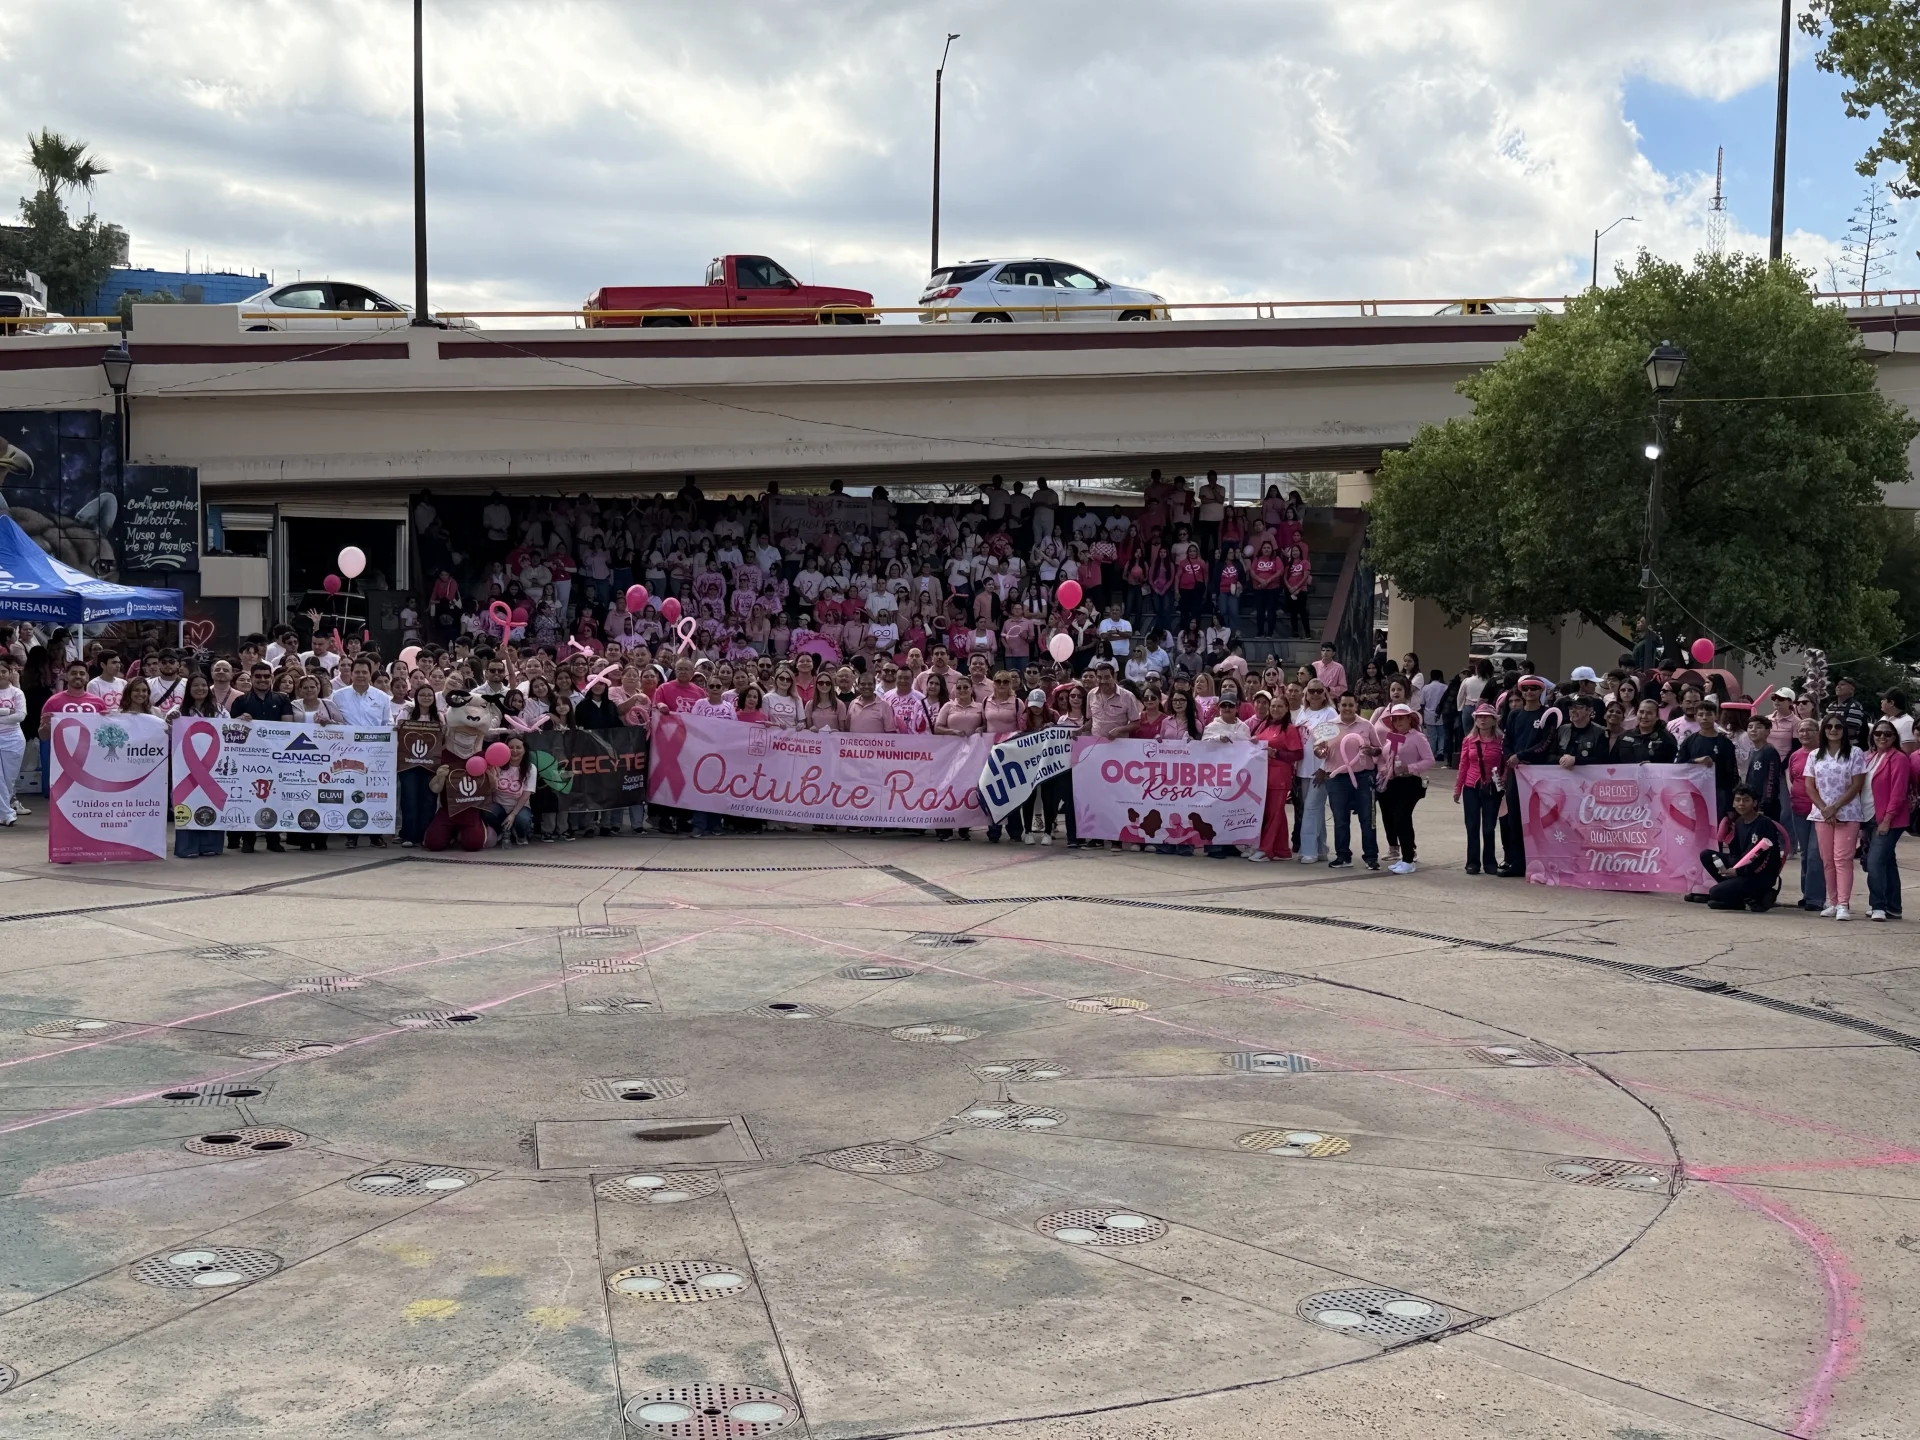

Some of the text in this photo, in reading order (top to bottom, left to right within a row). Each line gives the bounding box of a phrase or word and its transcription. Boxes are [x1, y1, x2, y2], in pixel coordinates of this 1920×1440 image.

[127, 527, 172, 540] Museo de
[143, 541, 155, 551] de
[772, 741, 822, 755] NOGALES
[885, 739, 895, 747] DE
[127, 743, 164, 757] index
[839, 748, 934, 761] SALUD MUNICIPAL
[1159, 748, 1190, 756] MUNICIPAL
[127, 757, 155, 765] Nogales
[272, 752, 331, 762] CANACO
[242, 764, 273, 774] NAOA
[1101, 759, 1232, 787] OCTUBRE
[320, 771, 355, 784] Kuroda
[623, 774, 644, 784] Sonora
[693, 753, 980, 811] Octubre Rosa
[1142, 773, 1197, 801] Rosa
[125, 799, 133, 807] la
[135, 799, 160, 807] lucha
[72, 808, 160, 818] contra el cáncer de
[731, 803, 745, 811] MES
[815, 812, 825, 820] DE
[836, 813, 859, 821] LUCHA
[859, 814, 888, 823] CONTRA
[932, 816, 956, 824] MAMA
[1579, 794, 1654, 829] Cancer
[1236, 813, 1258, 826] vida
[1590, 830, 1648, 844] AWARENESS
[1585, 846, 1661, 874] Month
